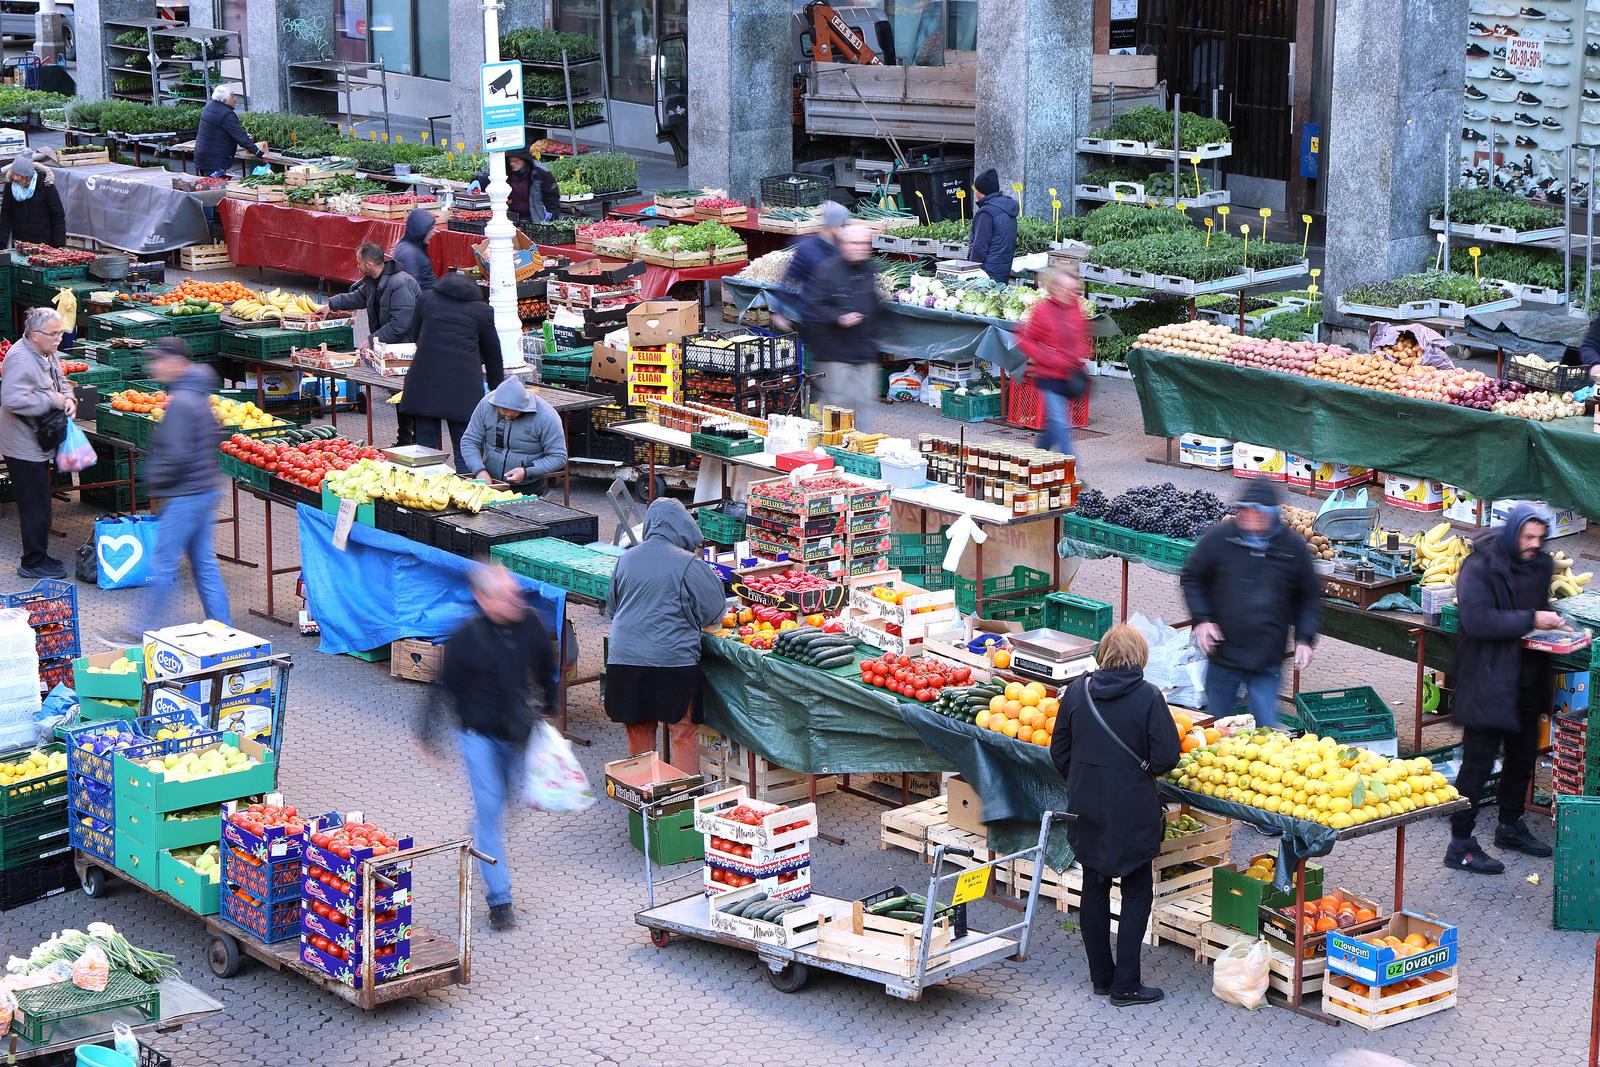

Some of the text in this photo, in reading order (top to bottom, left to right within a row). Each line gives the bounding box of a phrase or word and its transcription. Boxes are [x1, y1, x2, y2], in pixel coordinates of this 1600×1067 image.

[835, 19, 859, 45] FASSI
[1513, 40, 1539, 48] POPUST
[638, 352, 661, 362] ELIANI
[638, 373, 661, 382] ELIANI
[762, 499, 784, 508] DELUXE
[851, 502, 872, 511] DELUXE
[810, 507, 829, 516] DELUXE
[851, 521, 872, 530] DELUXE
[760, 543, 781, 552] DELUXE
[852, 545, 873, 553] DELUXE
[805, 551, 826, 559] DELUXE
[851, 567, 871, 575] DELUXE
[222, 652, 251, 663] BANANAS
[158, 651, 183, 674] derby
[222, 698, 250, 708] BANANAS
[736, 826, 755, 839] Maria
[753, 925, 773, 939] Maria
